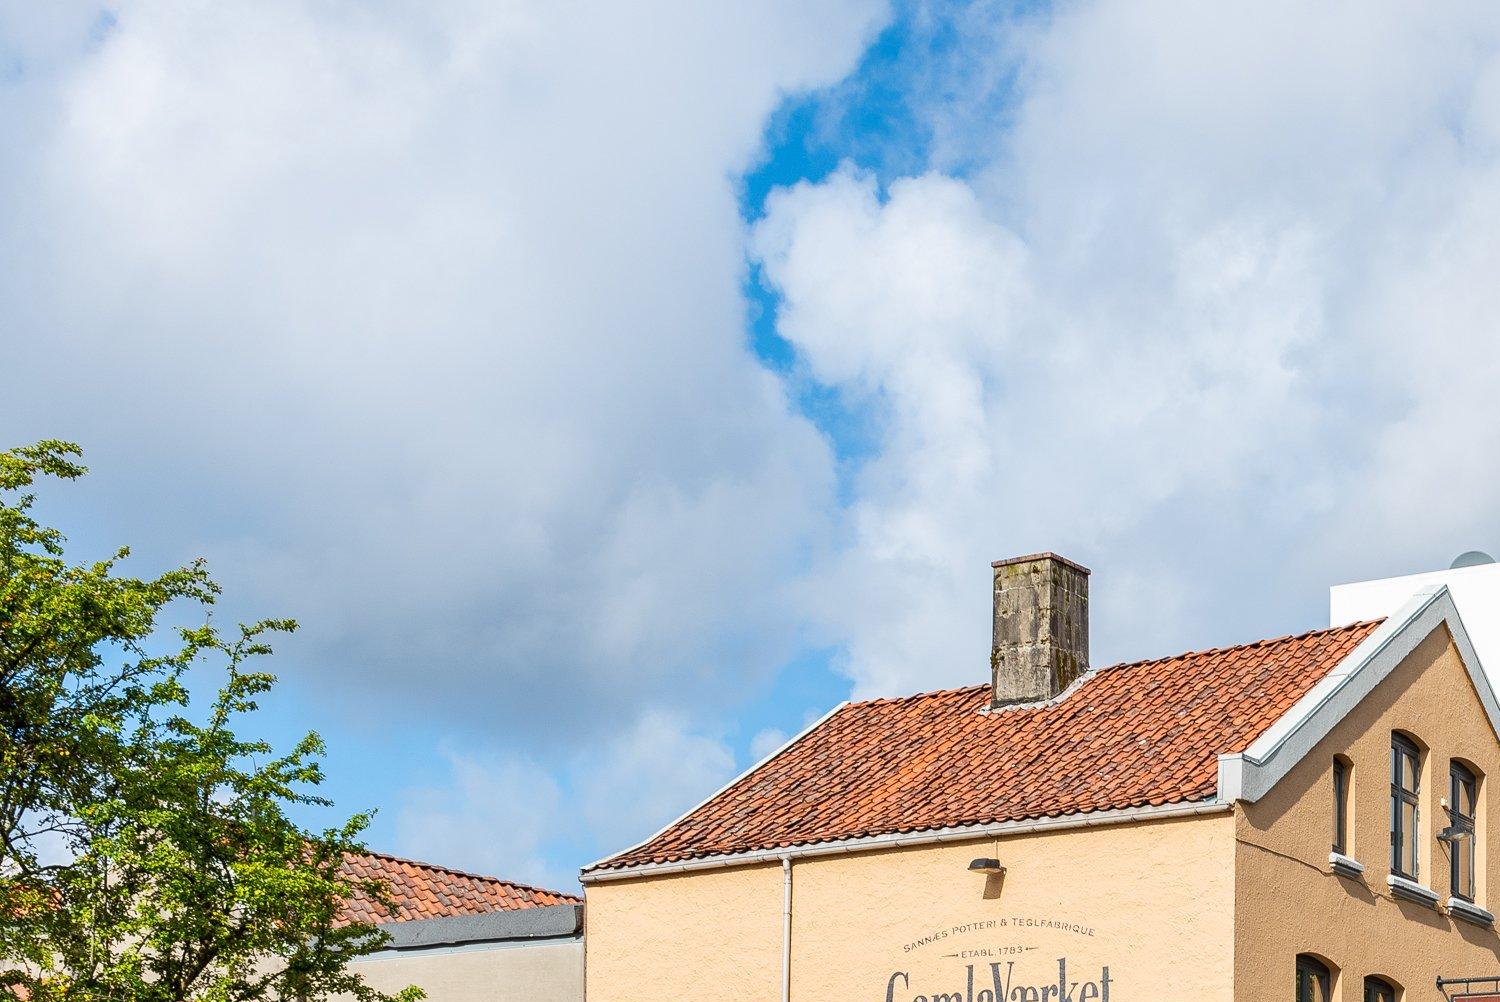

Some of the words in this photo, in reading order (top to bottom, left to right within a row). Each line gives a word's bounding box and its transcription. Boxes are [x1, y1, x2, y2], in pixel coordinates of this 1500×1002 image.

[903, 930, 948, 953] SANNÆS
[952, 920, 996, 935] POTTERI
[1000, 918, 1008, 927] &
[1011, 917, 1096, 937] TEGLFABRIQUE
[999, 946, 1023, 955] 1783
